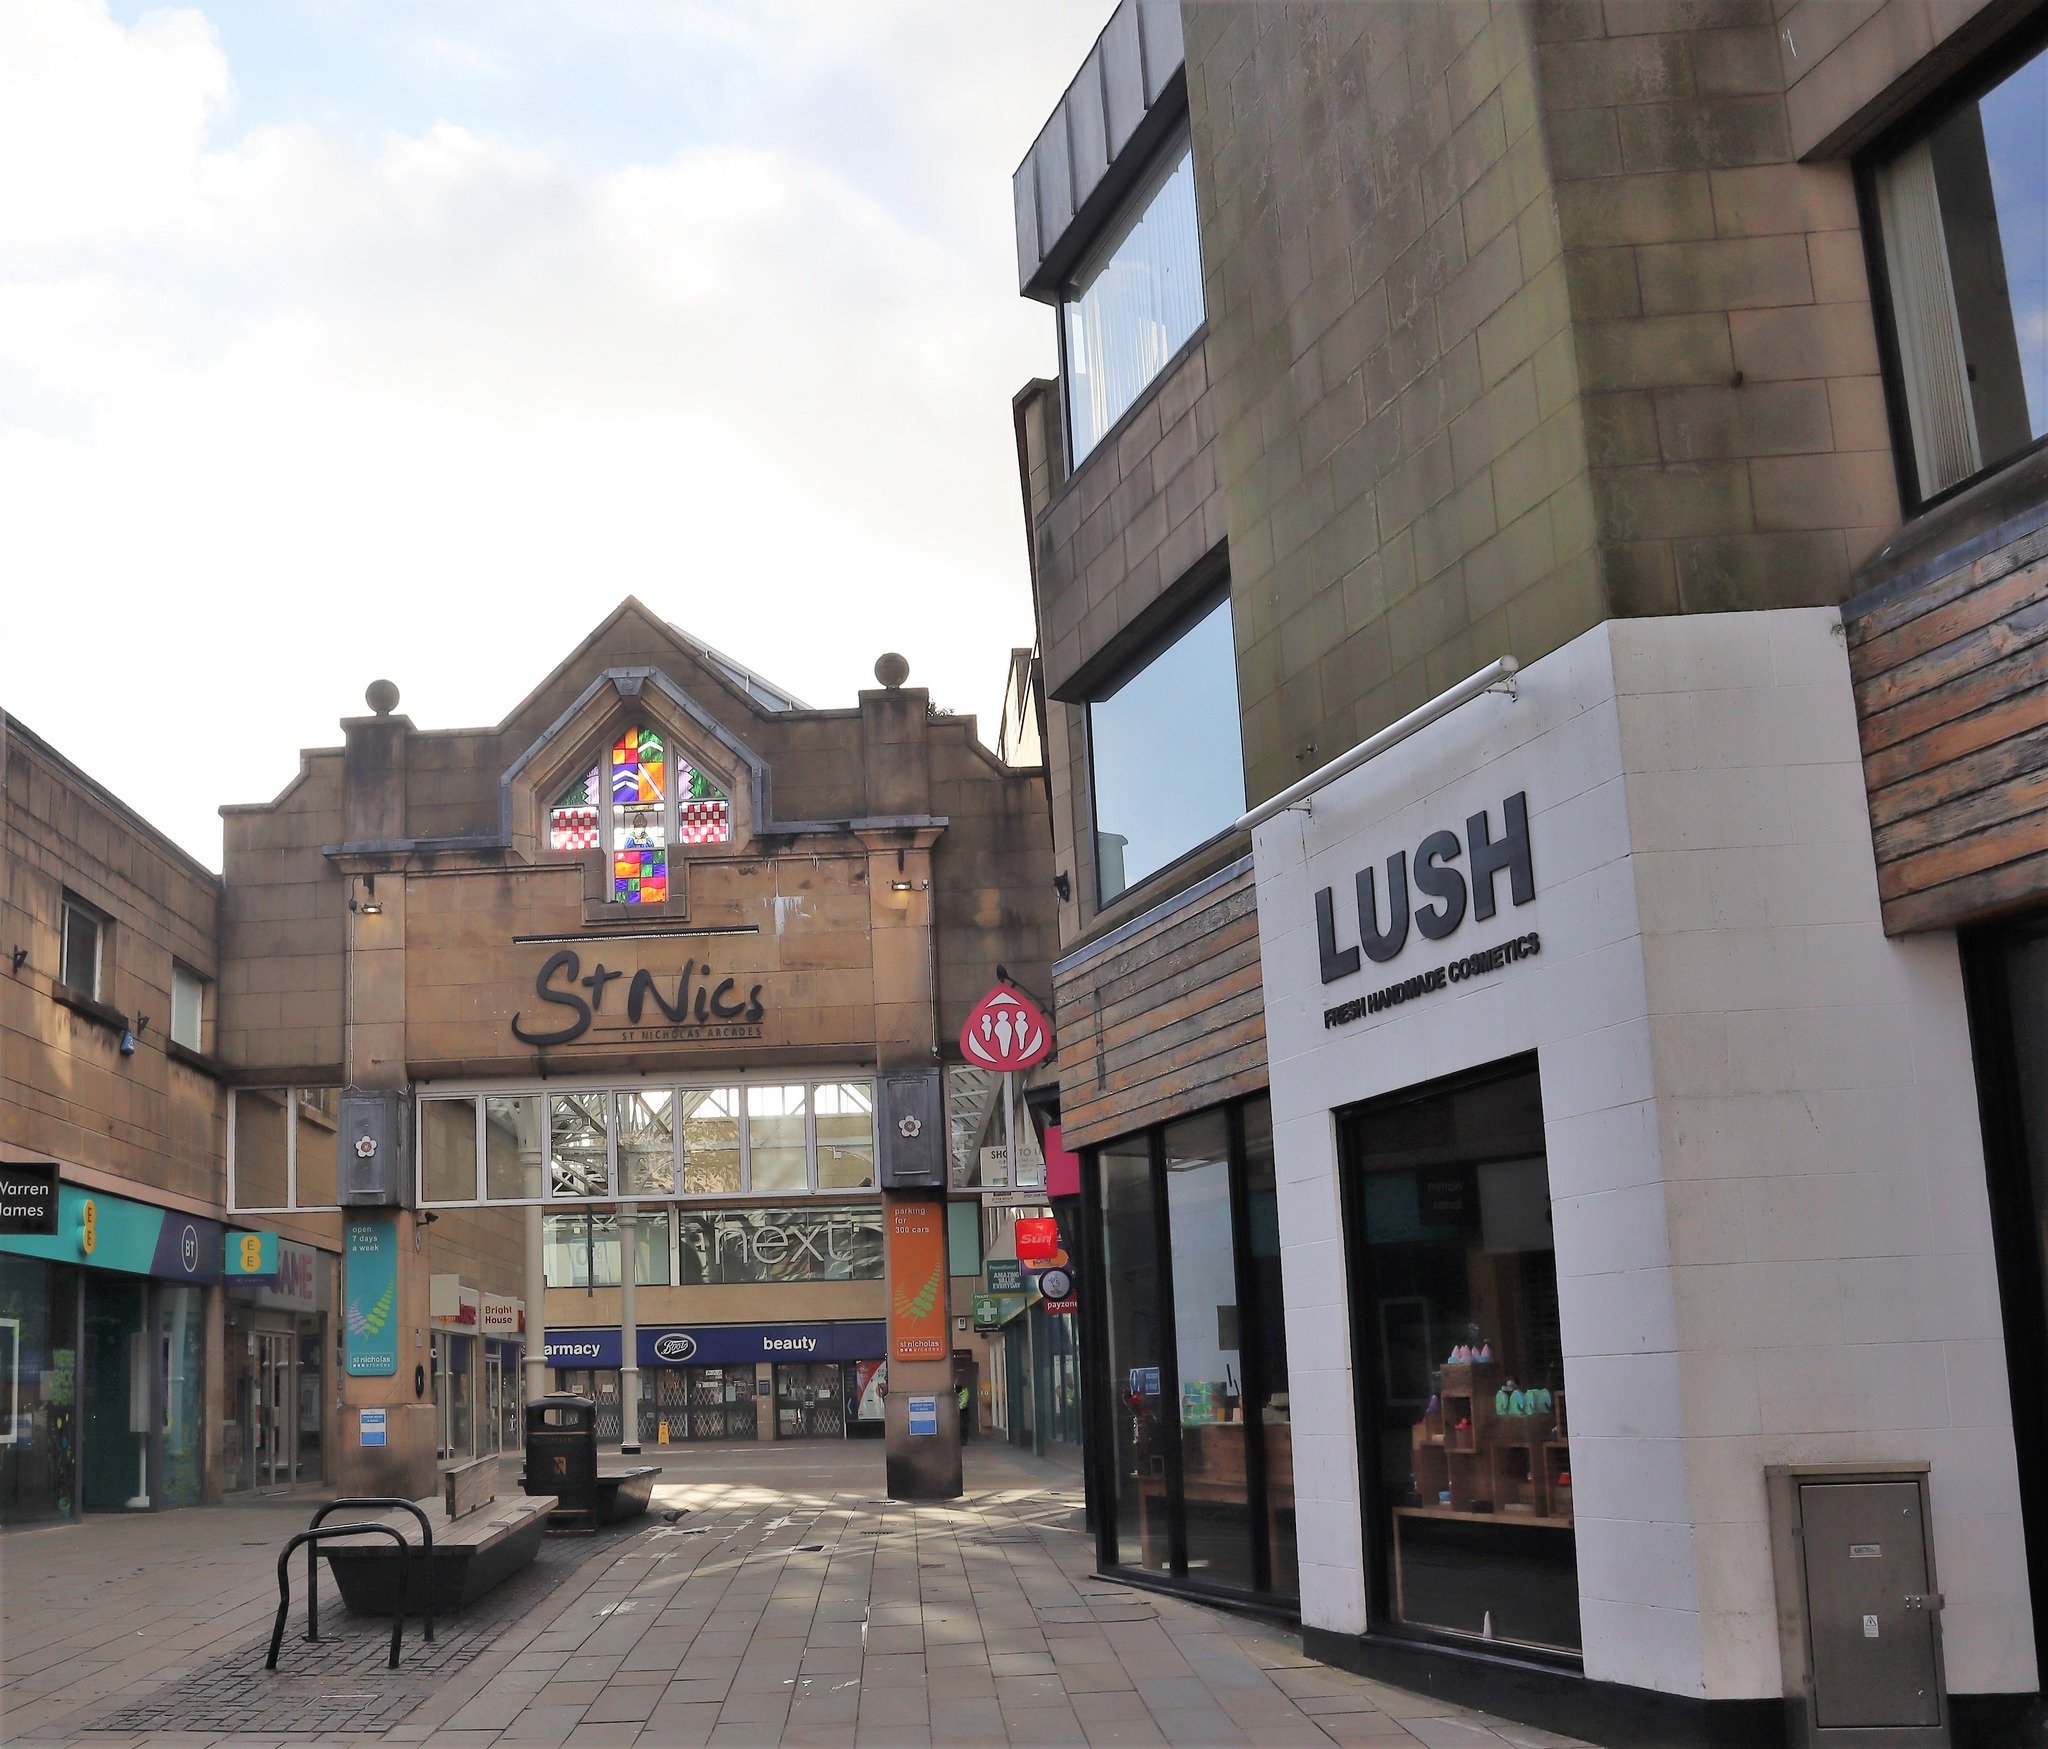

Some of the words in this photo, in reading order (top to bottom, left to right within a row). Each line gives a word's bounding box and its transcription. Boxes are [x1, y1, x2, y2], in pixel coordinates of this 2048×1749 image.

[1315, 791, 1536, 985] LUSH
[1324, 996, 1367, 1029] FRESH
[1367, 966, 1447, 1014] HANDMADE
[1448, 931, 1541, 982] COSMETICS
[511, 950, 622, 1045] St
[628, 958, 764, 1023] Nics
[622, 1031, 634, 1041] ST
[642, 1028, 700, 1040] NICHOLAS
[707, 1026, 762, 1037] ARCADES
[894, 1208, 926, 1216] parking
[352, 1226, 372, 1234] open
[896, 1226, 910, 1234] 300
[360, 1235, 378, 1244] days
[715, 1222, 855, 1265] next
[185, 1240, 195, 1258] BT
[485, 1306, 512, 1315] Bright
[485, 1316, 512, 1324] House
[763, 1336, 817, 1352] beauty
